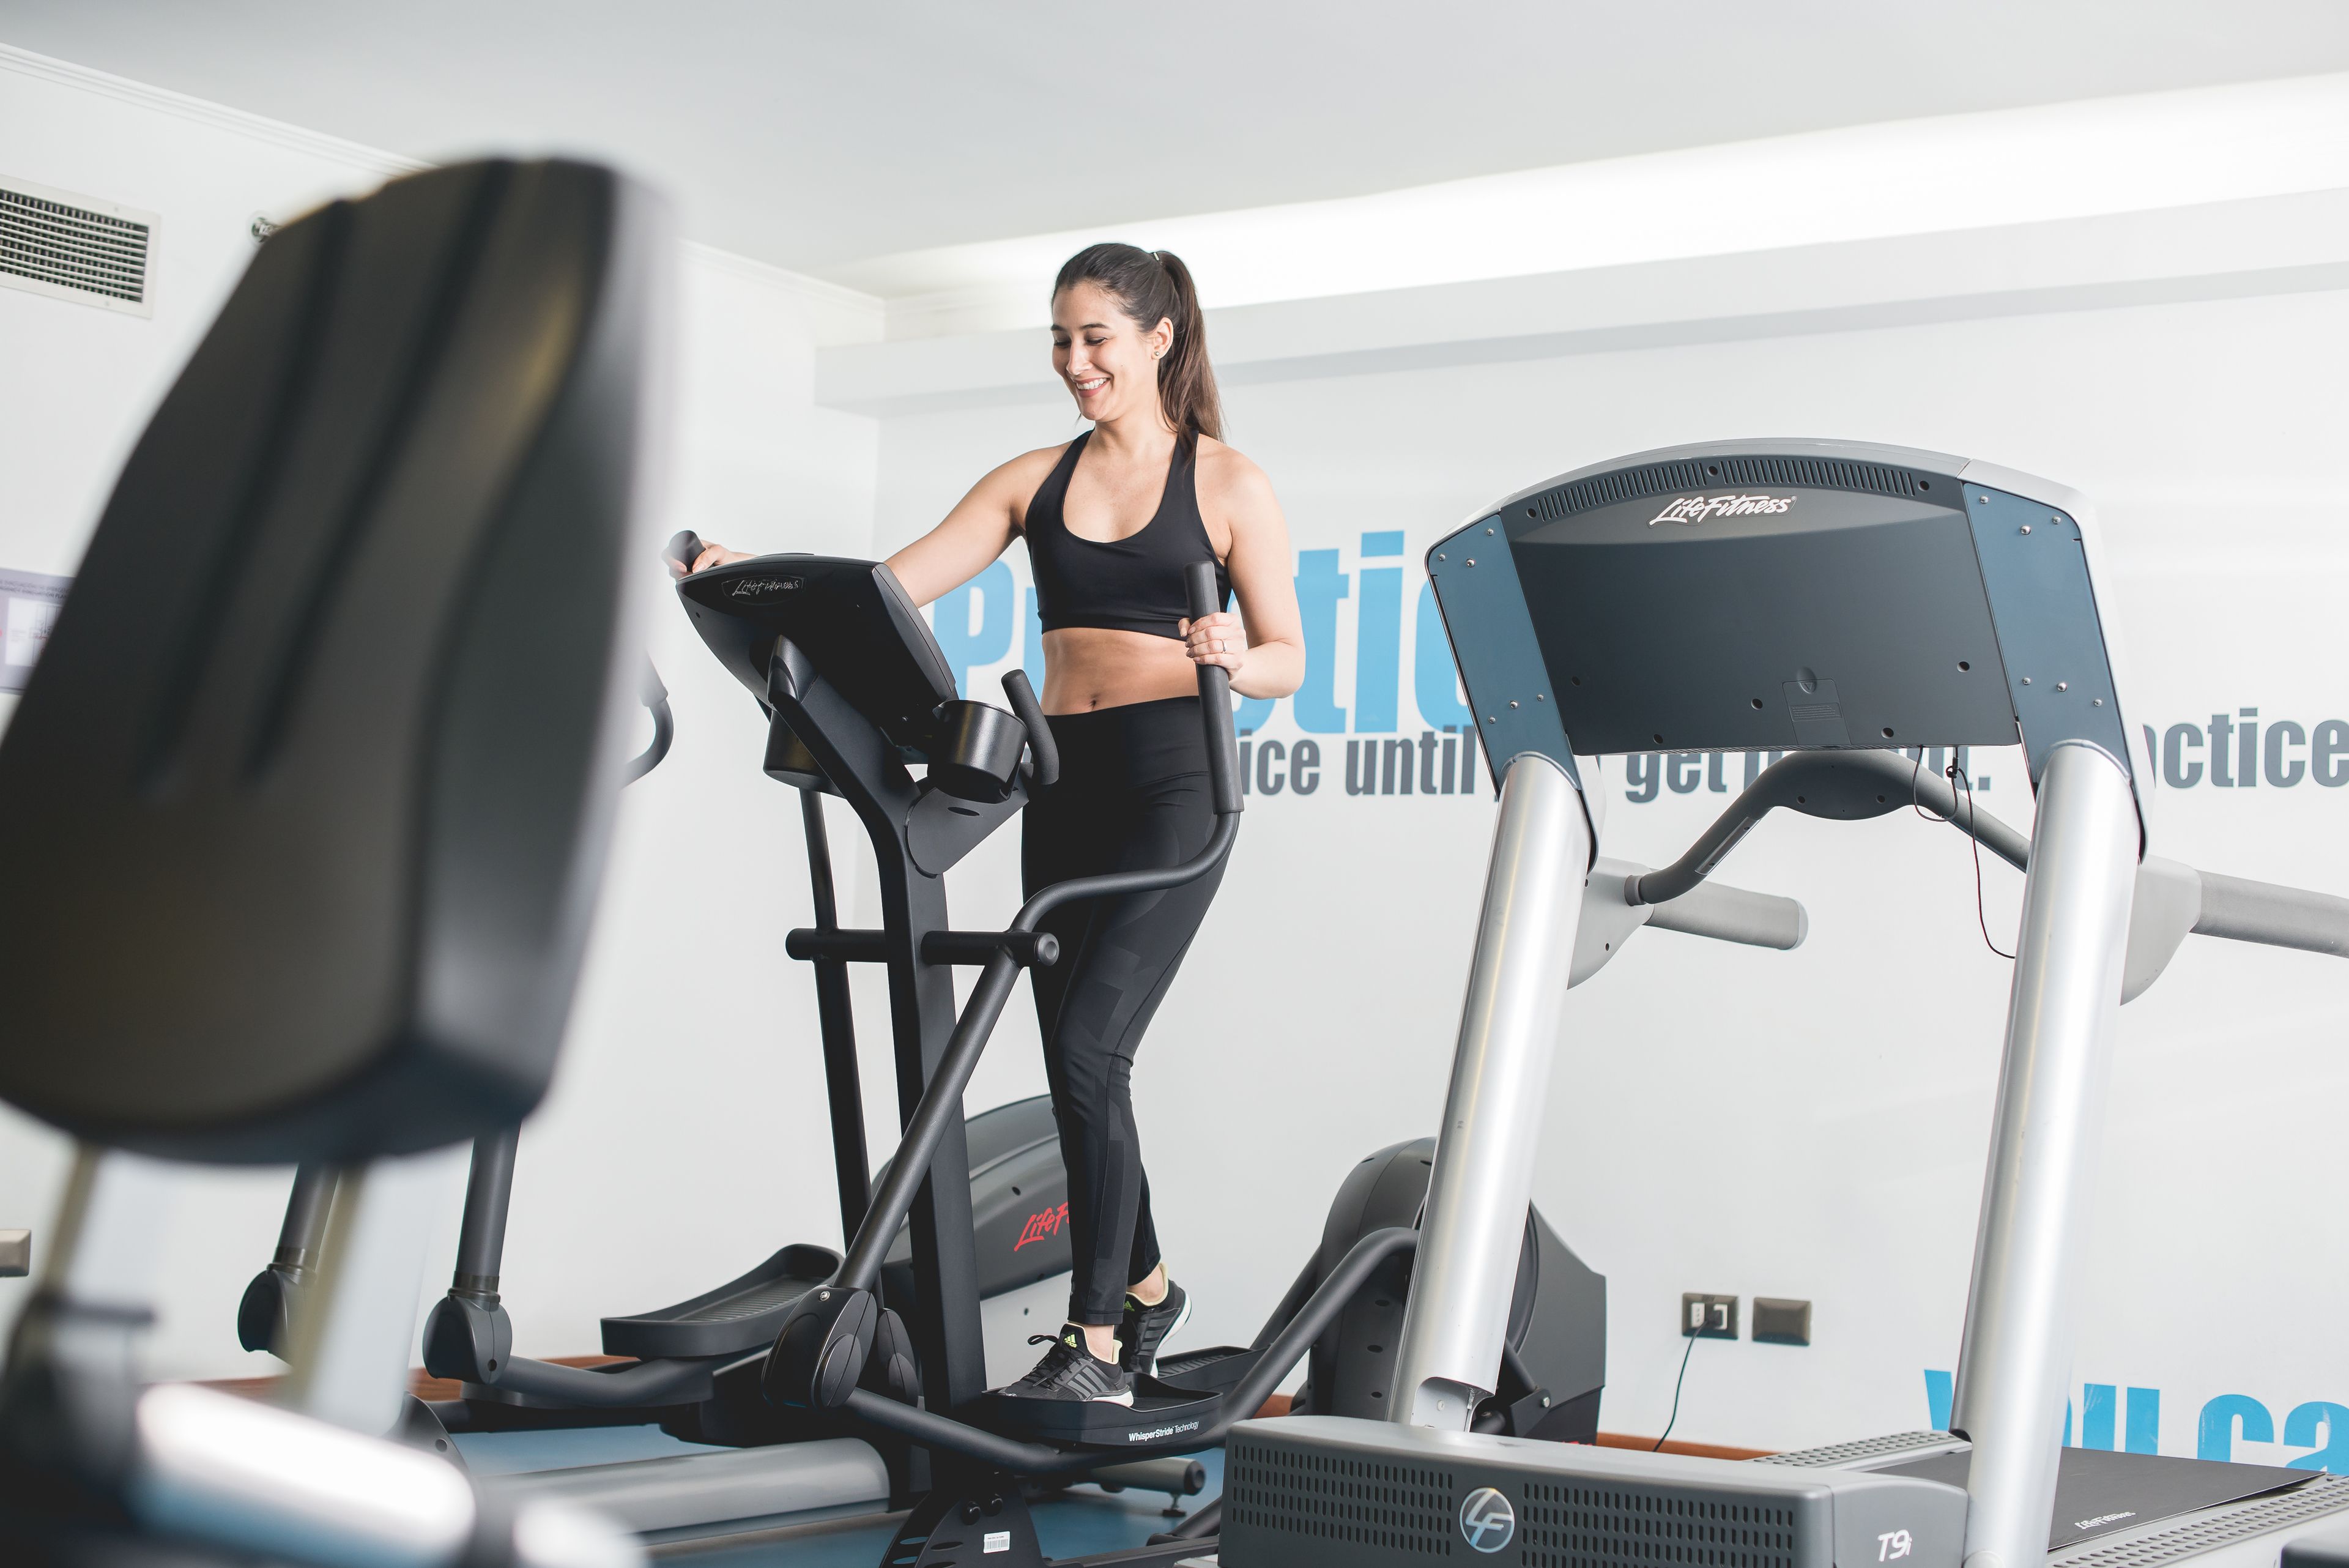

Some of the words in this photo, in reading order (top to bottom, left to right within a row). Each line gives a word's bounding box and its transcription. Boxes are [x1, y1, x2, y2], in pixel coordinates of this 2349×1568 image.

[1345, 724, 1475, 795] until
[1174, 1421, 1200, 1433] Technology
[1877, 1529, 1912, 1562] T9i
